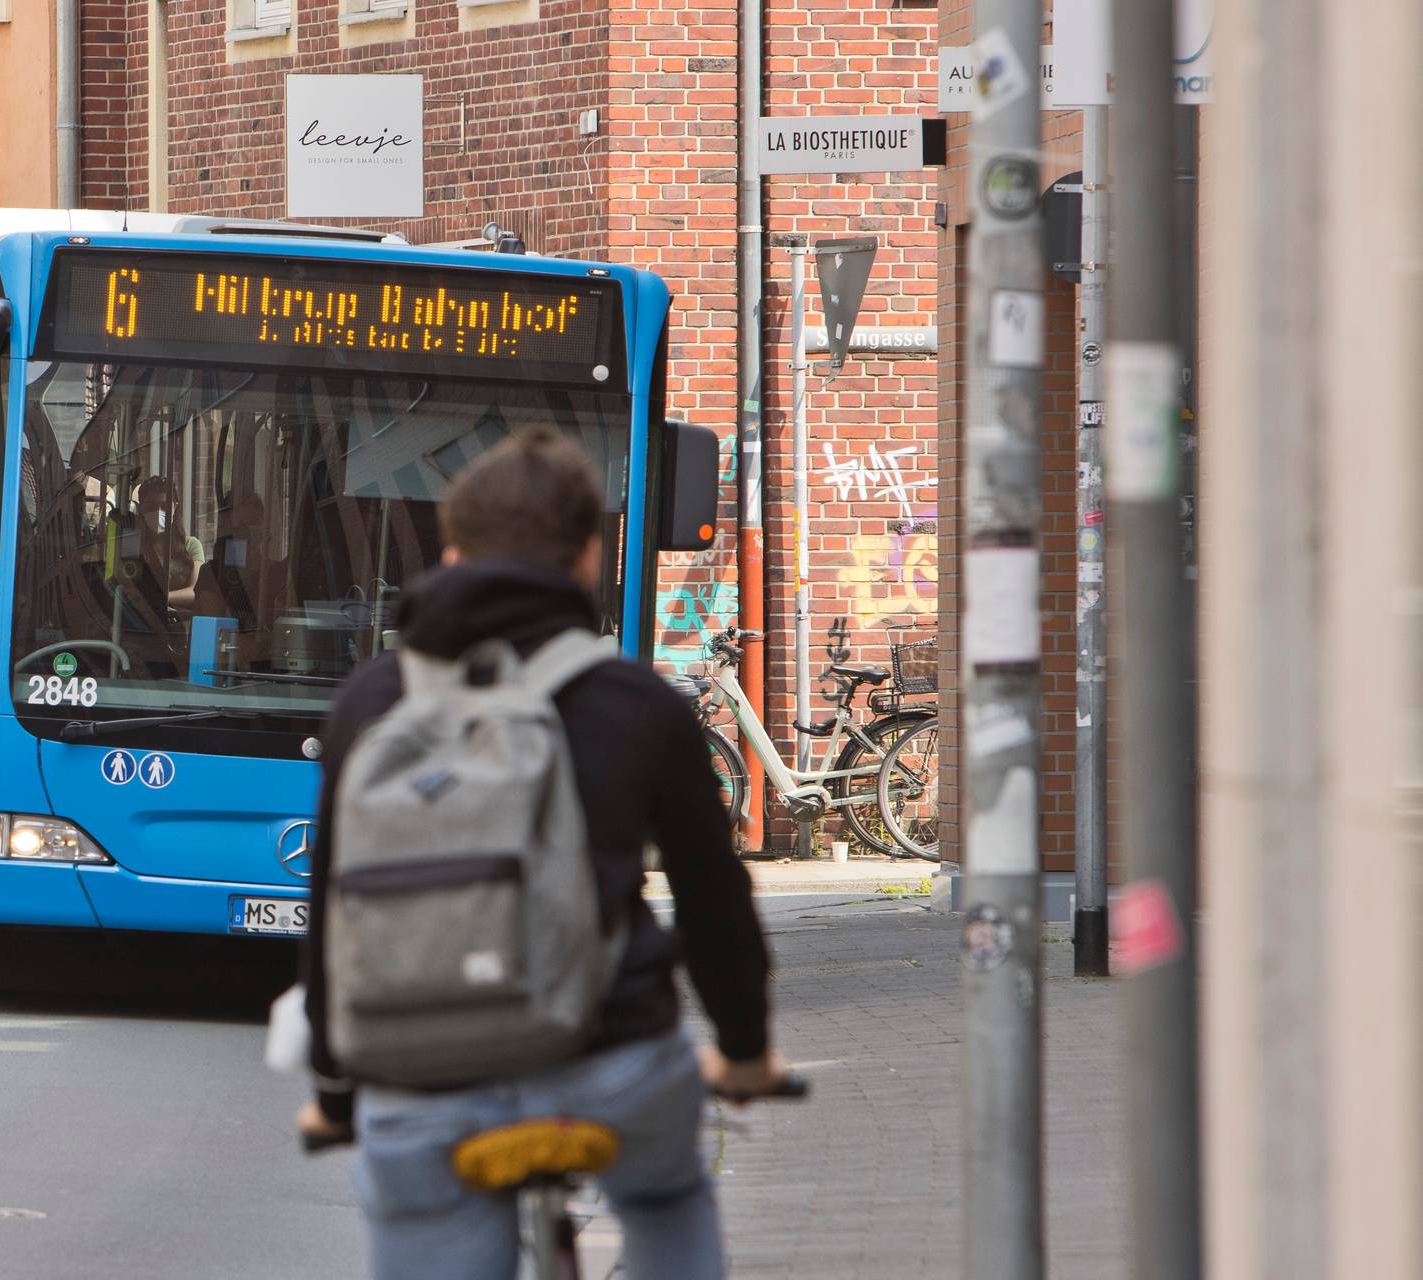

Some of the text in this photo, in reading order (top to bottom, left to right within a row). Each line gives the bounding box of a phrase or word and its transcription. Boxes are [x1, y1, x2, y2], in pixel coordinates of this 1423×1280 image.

[298, 119, 413, 154] leevje
[767, 132, 786, 151] LA
[824, 151, 856, 160] PARIS
[105, 268, 139, 338] 6
[816, 332, 926, 349] Sngasse
[28, 675, 98, 708] 2848
[246, 903, 277, 925] MS
